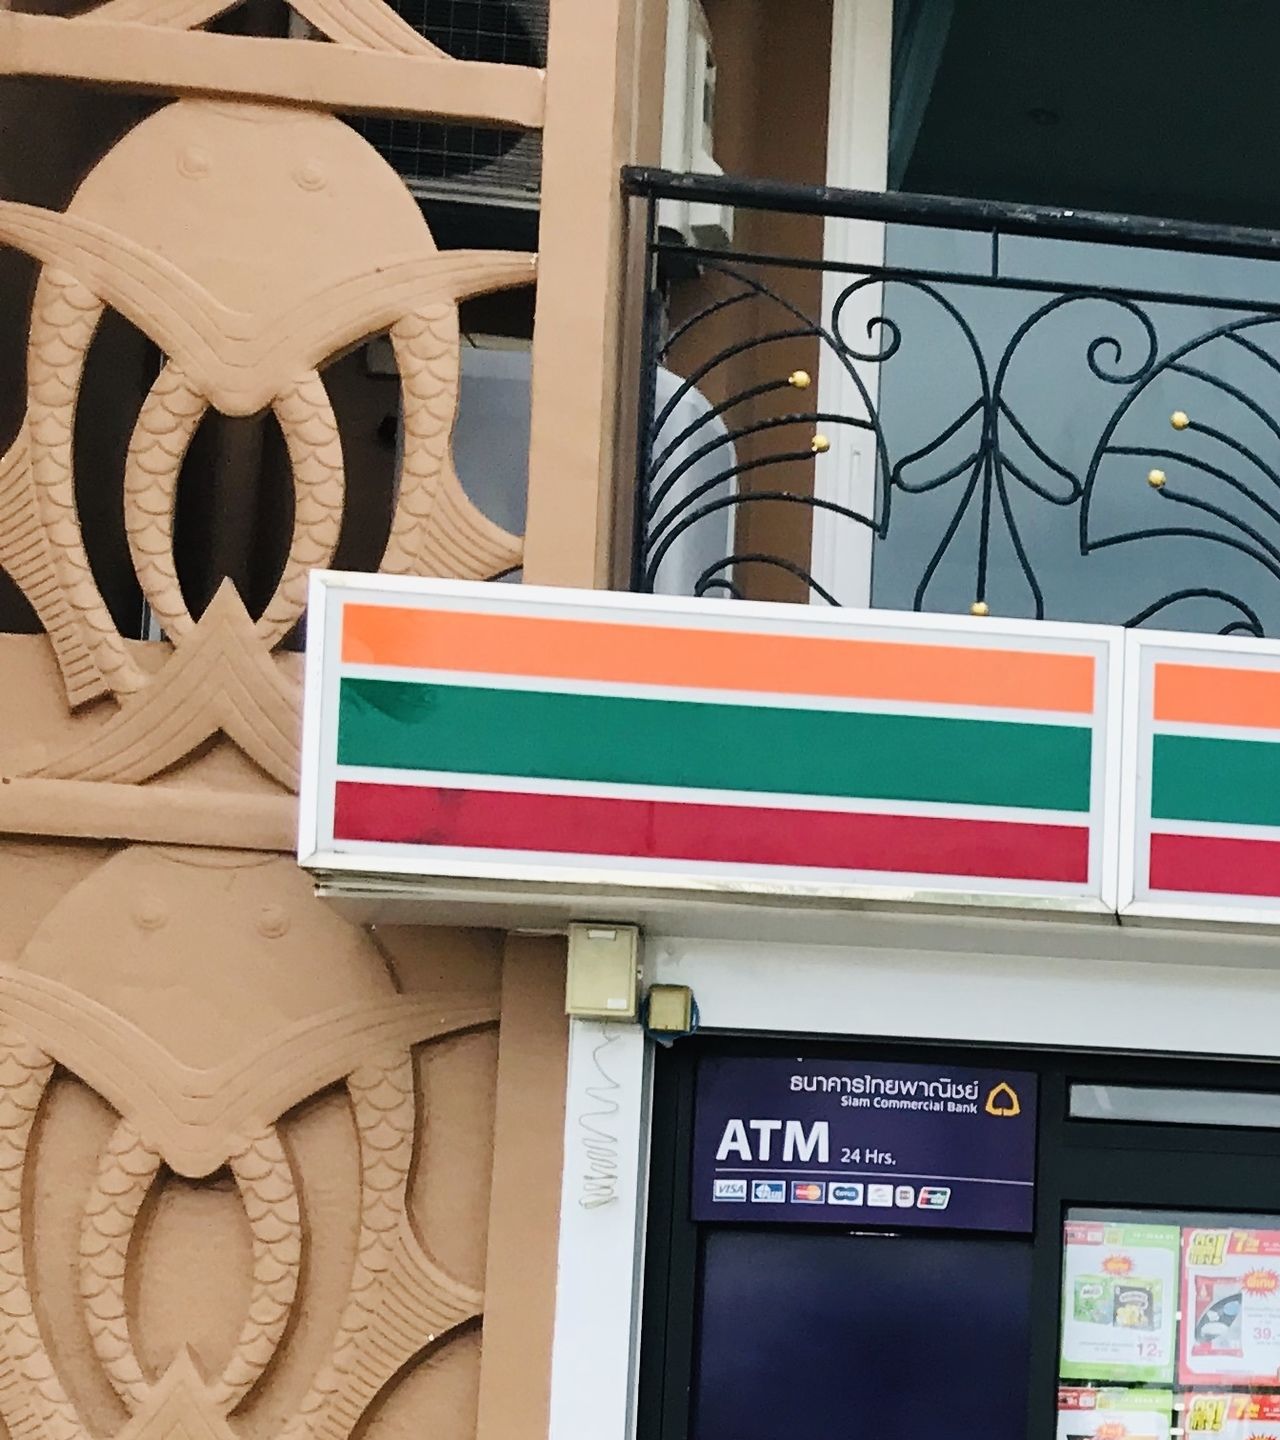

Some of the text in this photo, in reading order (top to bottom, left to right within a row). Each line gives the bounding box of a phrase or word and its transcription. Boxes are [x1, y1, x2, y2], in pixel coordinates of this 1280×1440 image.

[790, 1075, 979, 1100] ธนาคารไทยพาณิชย์
[841, 1095, 978, 1114] Siam Commercial Bank
[715, 1118, 896, 1166] ATM 24 Hrs.
[718, 1184, 745, 1195] VISA
